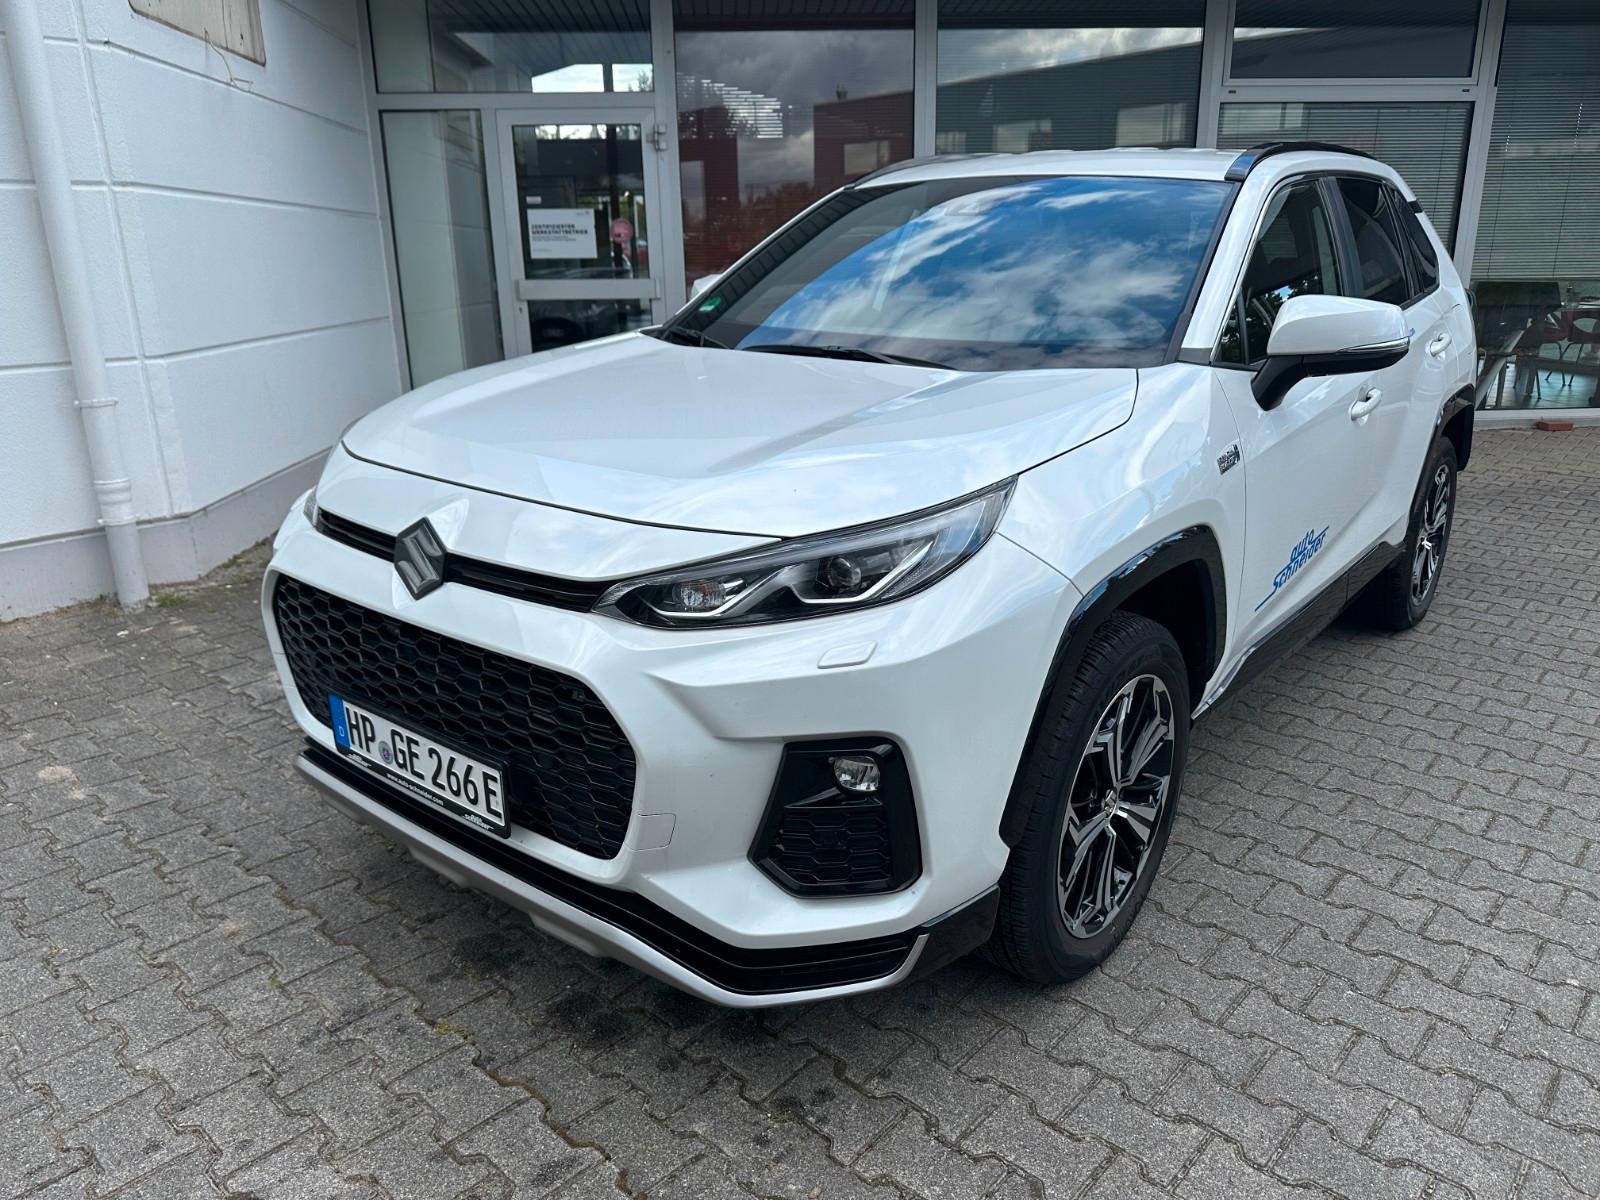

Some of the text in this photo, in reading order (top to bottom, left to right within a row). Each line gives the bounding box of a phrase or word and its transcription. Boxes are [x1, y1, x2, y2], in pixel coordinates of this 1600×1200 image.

[1290, 528, 1314, 562] auto
[338, 726, 345, 737] D
[345, 706, 376, 754] HP
[390, 728, 425, 780] GE
[386, 773, 444, 806] www.auto-schneider.com
